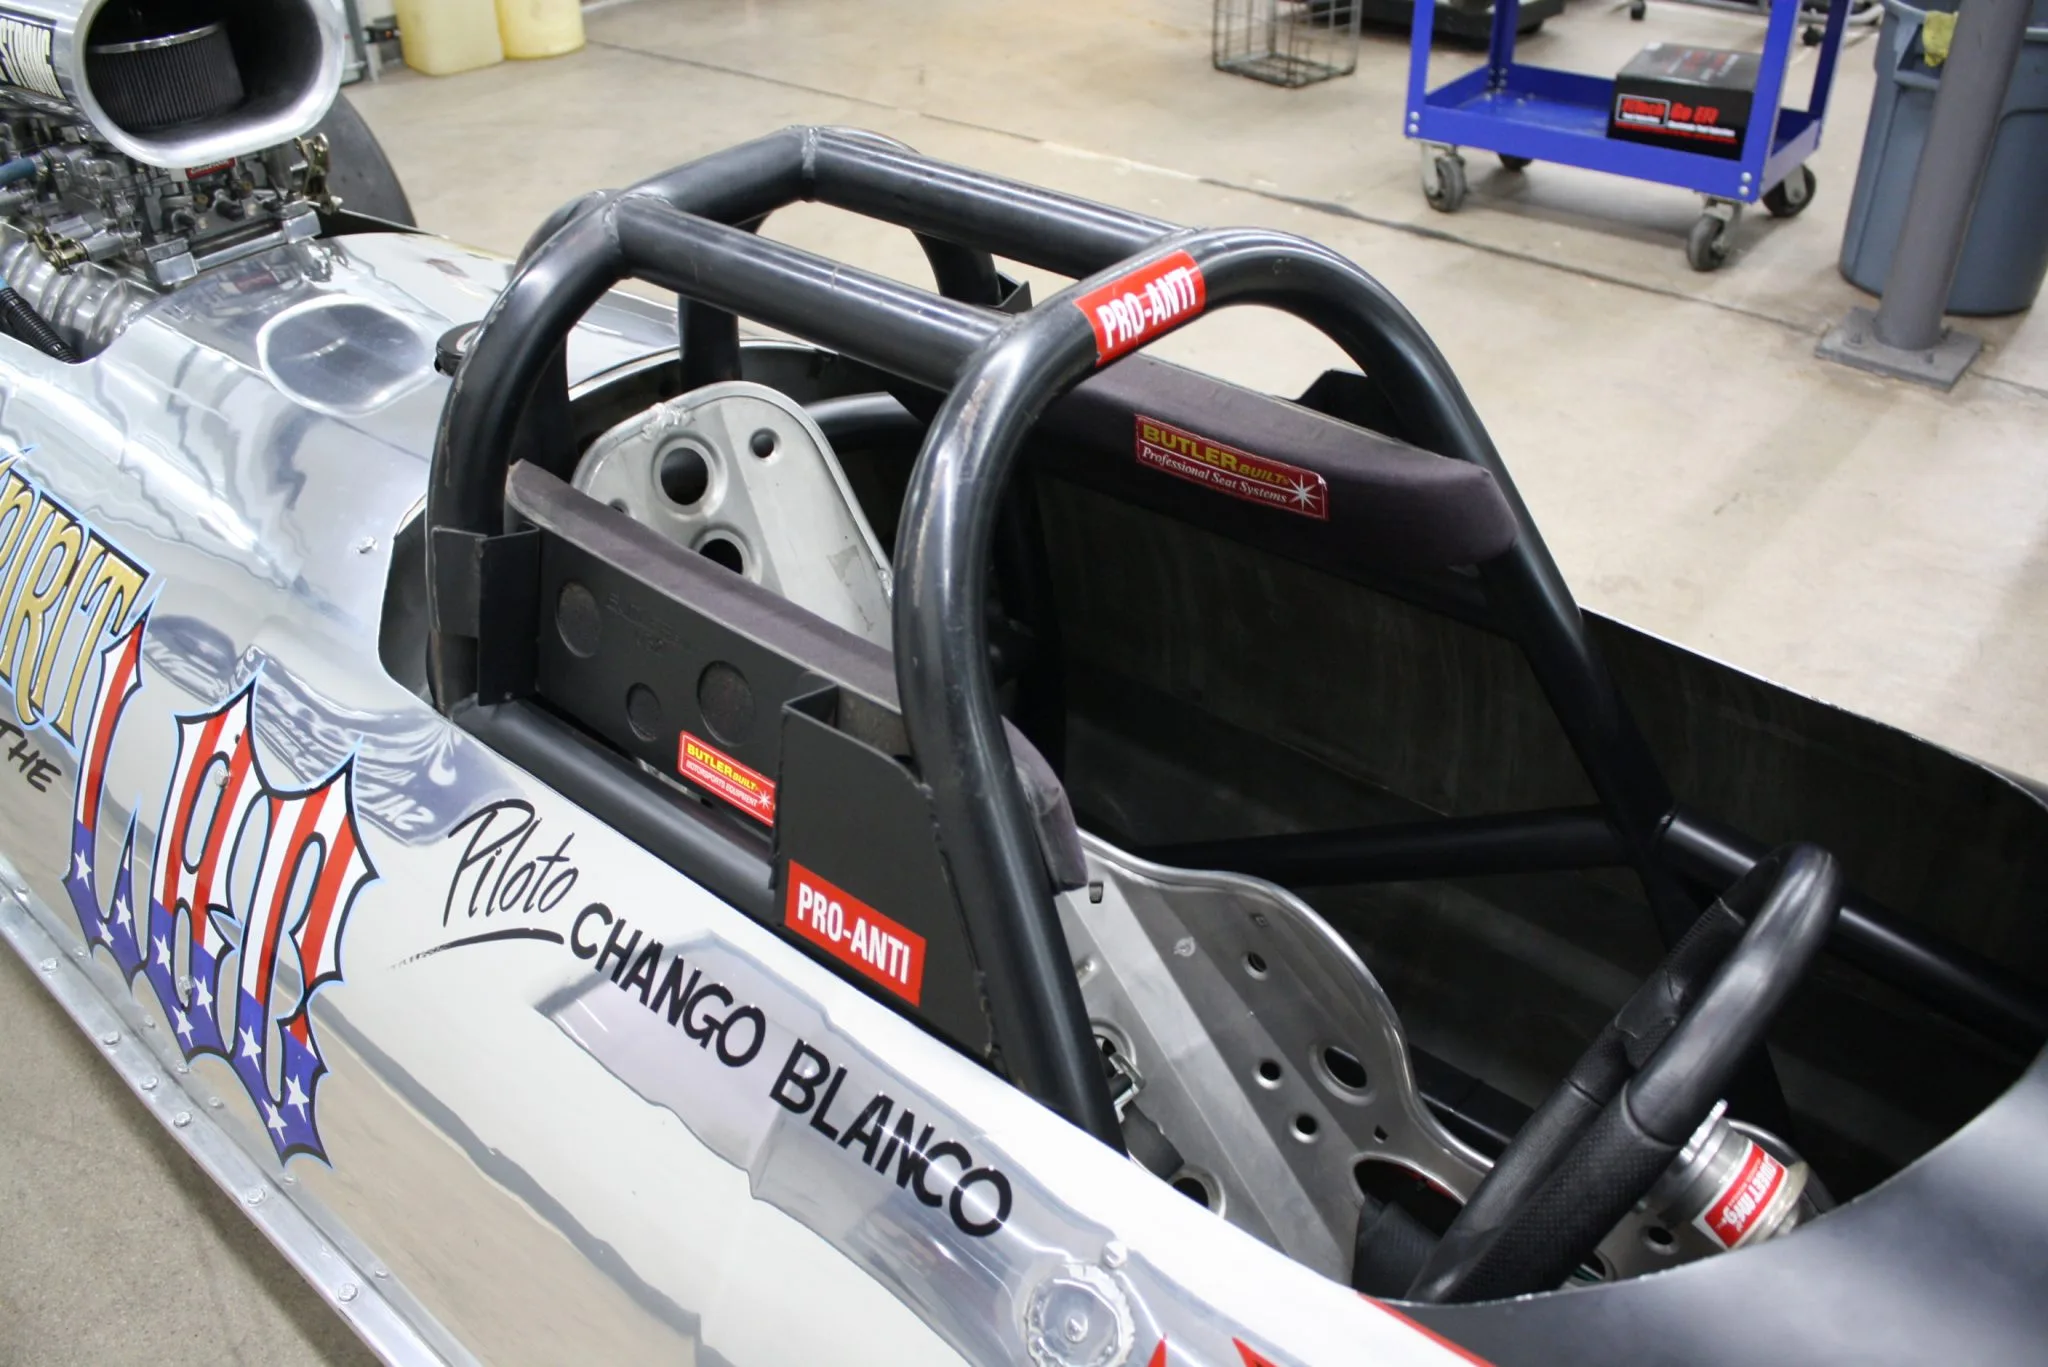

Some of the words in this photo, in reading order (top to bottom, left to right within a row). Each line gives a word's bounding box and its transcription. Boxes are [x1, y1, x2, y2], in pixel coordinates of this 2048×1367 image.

[1096, 266, 1196, 349] PRO-ANTI
[1142, 423, 1238, 472] BUTLER
[1142, 447, 1210, 480] Professional
[1211, 471, 1238, 488] Seat
[1239, 479, 1288, 503] Systems
[0, 462, 152, 750] PIRIT
[687, 743, 733, 778] BUTLER
[797, 881, 911, 985] PRO-ANTI
[443, 797, 579, 928] Piloto
[570, 902, 767, 1067] CHANGO
[769, 1040, 1013, 1237] BLANCO
